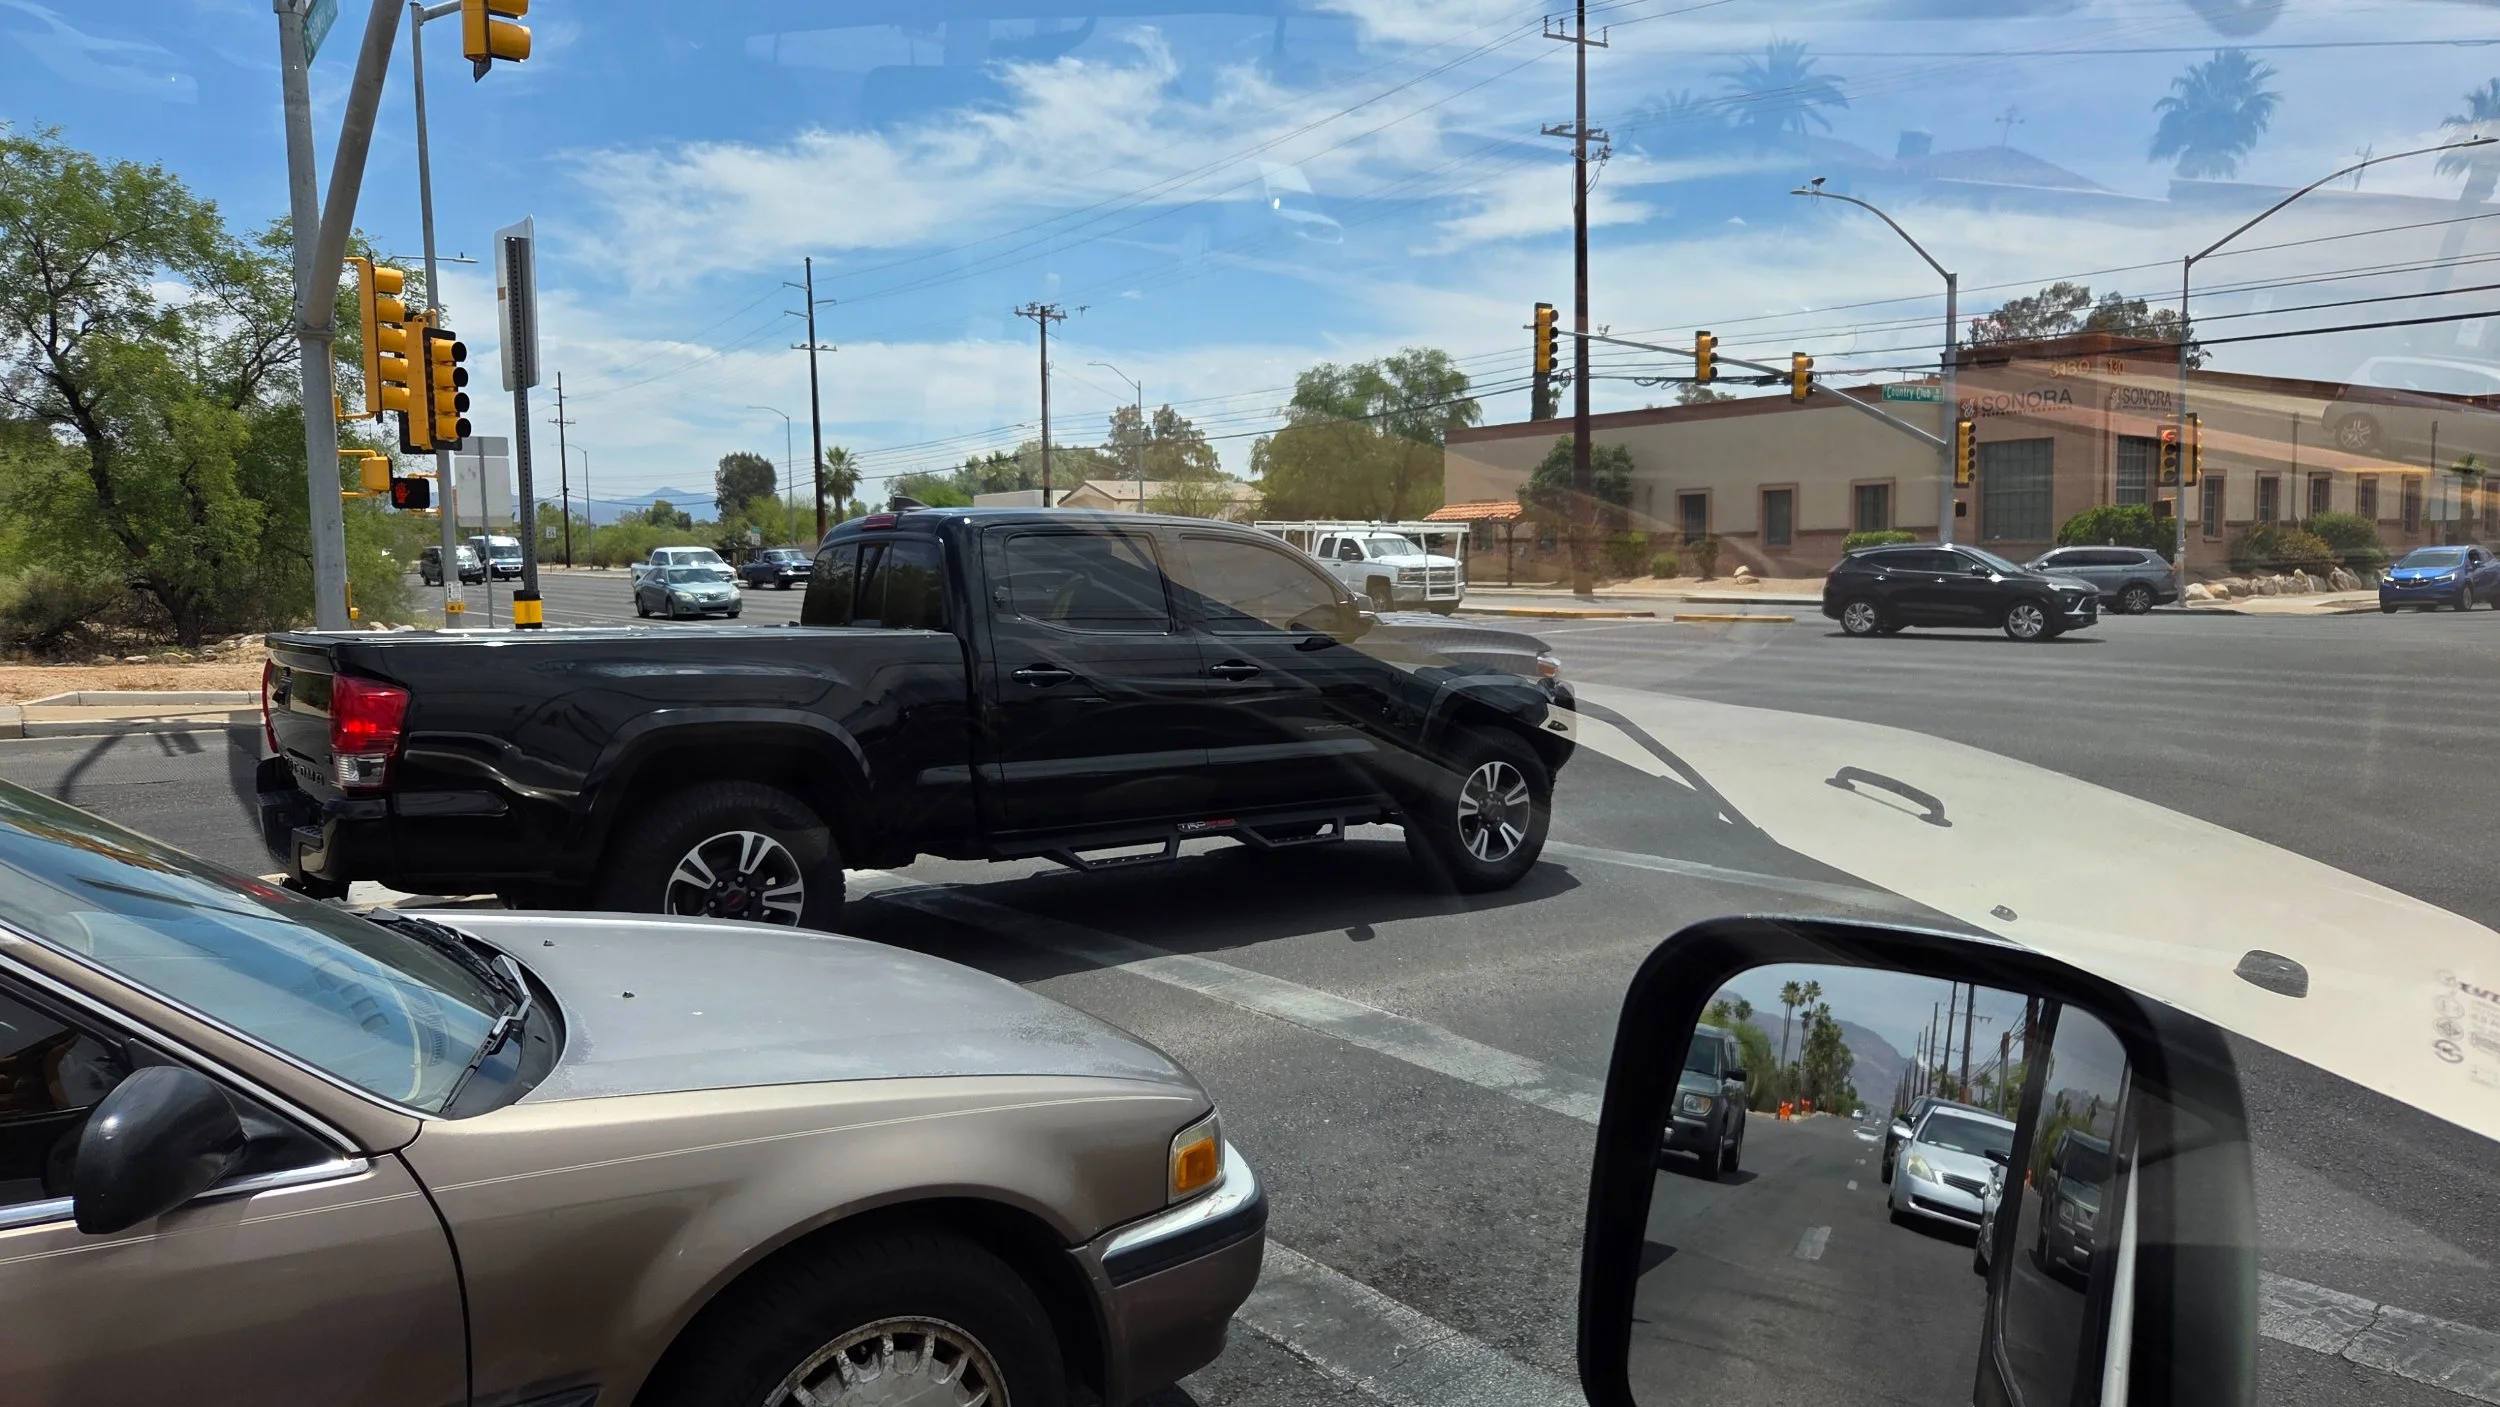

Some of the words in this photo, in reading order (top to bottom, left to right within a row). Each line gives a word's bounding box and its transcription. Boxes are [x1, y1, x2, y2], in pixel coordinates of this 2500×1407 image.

[1886, 385, 1914, 400] Country
[1916, 387, 1931, 399] Club
[1981, 388, 2073, 413] SONORA
[2122, 387, 2172, 407] SONORA
